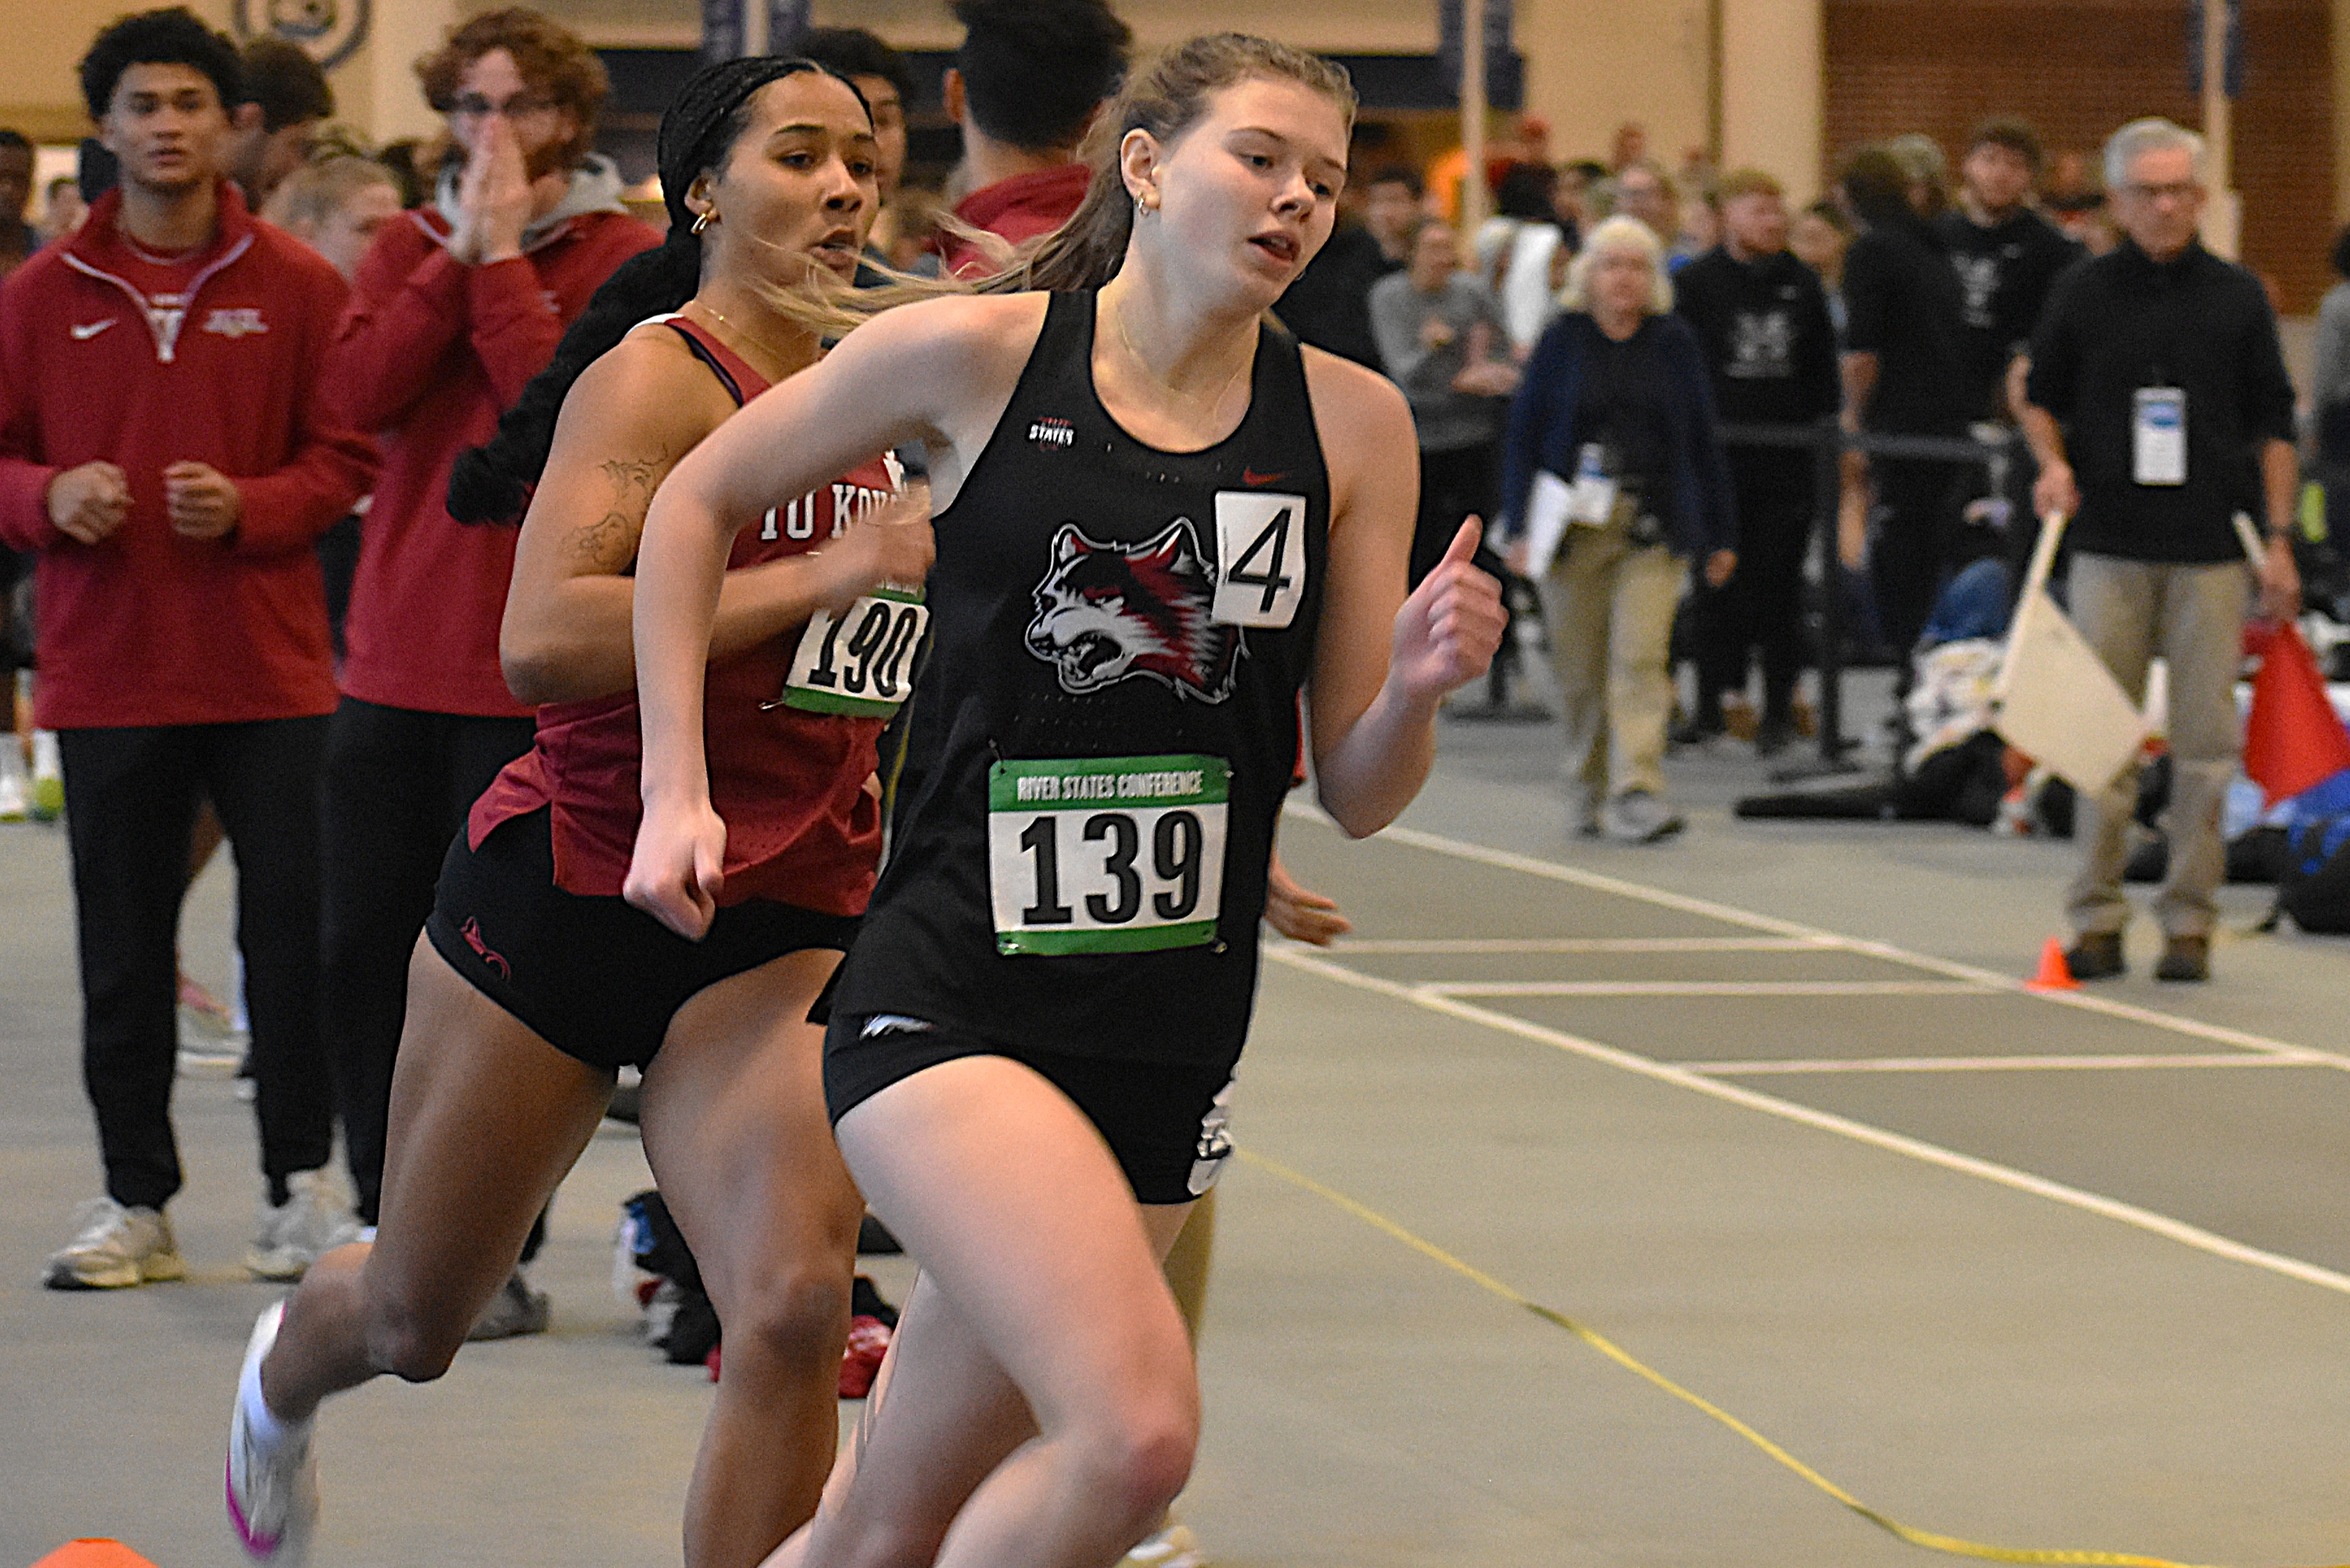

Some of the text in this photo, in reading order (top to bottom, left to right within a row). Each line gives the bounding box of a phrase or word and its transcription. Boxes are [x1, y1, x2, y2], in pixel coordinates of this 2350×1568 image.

[1228, 508, 1292, 613] 4
[808, 602, 918, 698] 190
[1017, 768, 1205, 802] RIVER STATES CONFERENCE
[1020, 810, 1202, 926] 139
